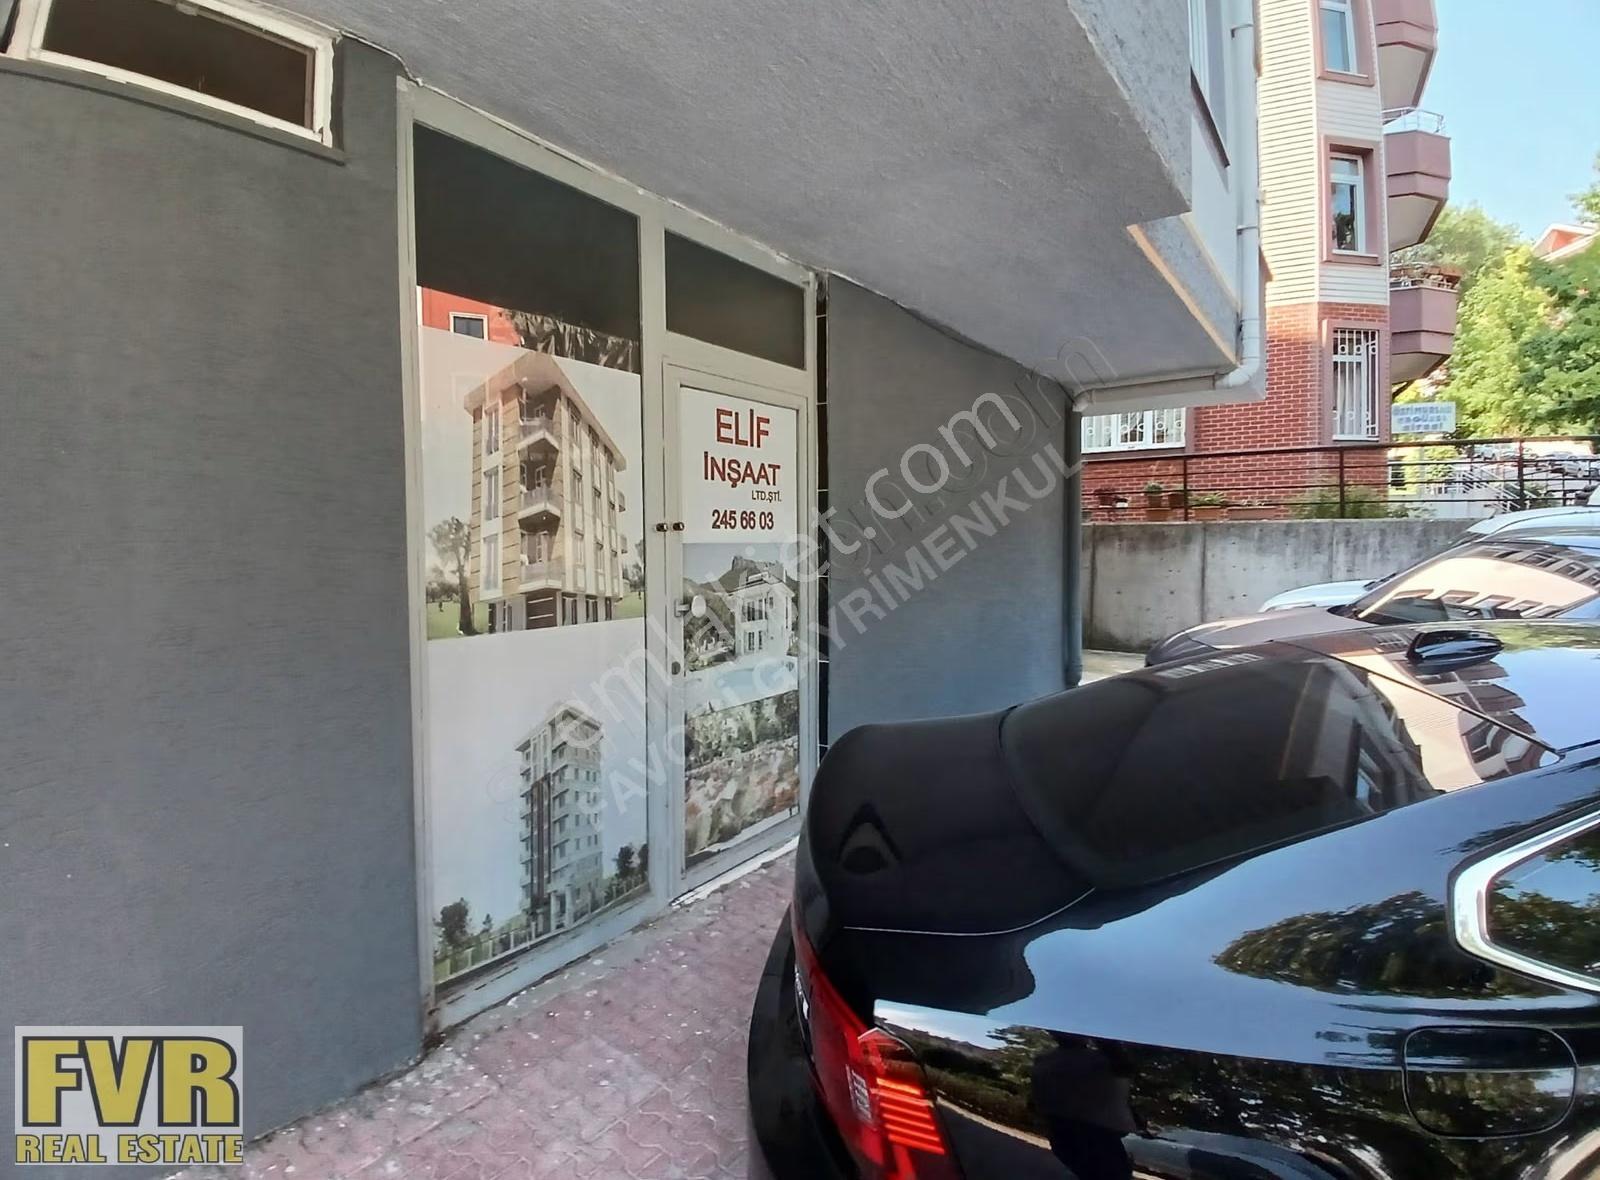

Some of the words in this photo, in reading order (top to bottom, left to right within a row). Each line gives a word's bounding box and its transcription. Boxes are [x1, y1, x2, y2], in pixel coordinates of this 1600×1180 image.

[716, 408, 770, 448] ELİF
[704, 451, 781, 488] İNŞAAT
[712, 509, 737, 530] 245
[740, 510, 756, 530] 66
[759, 511, 775, 531] 03
